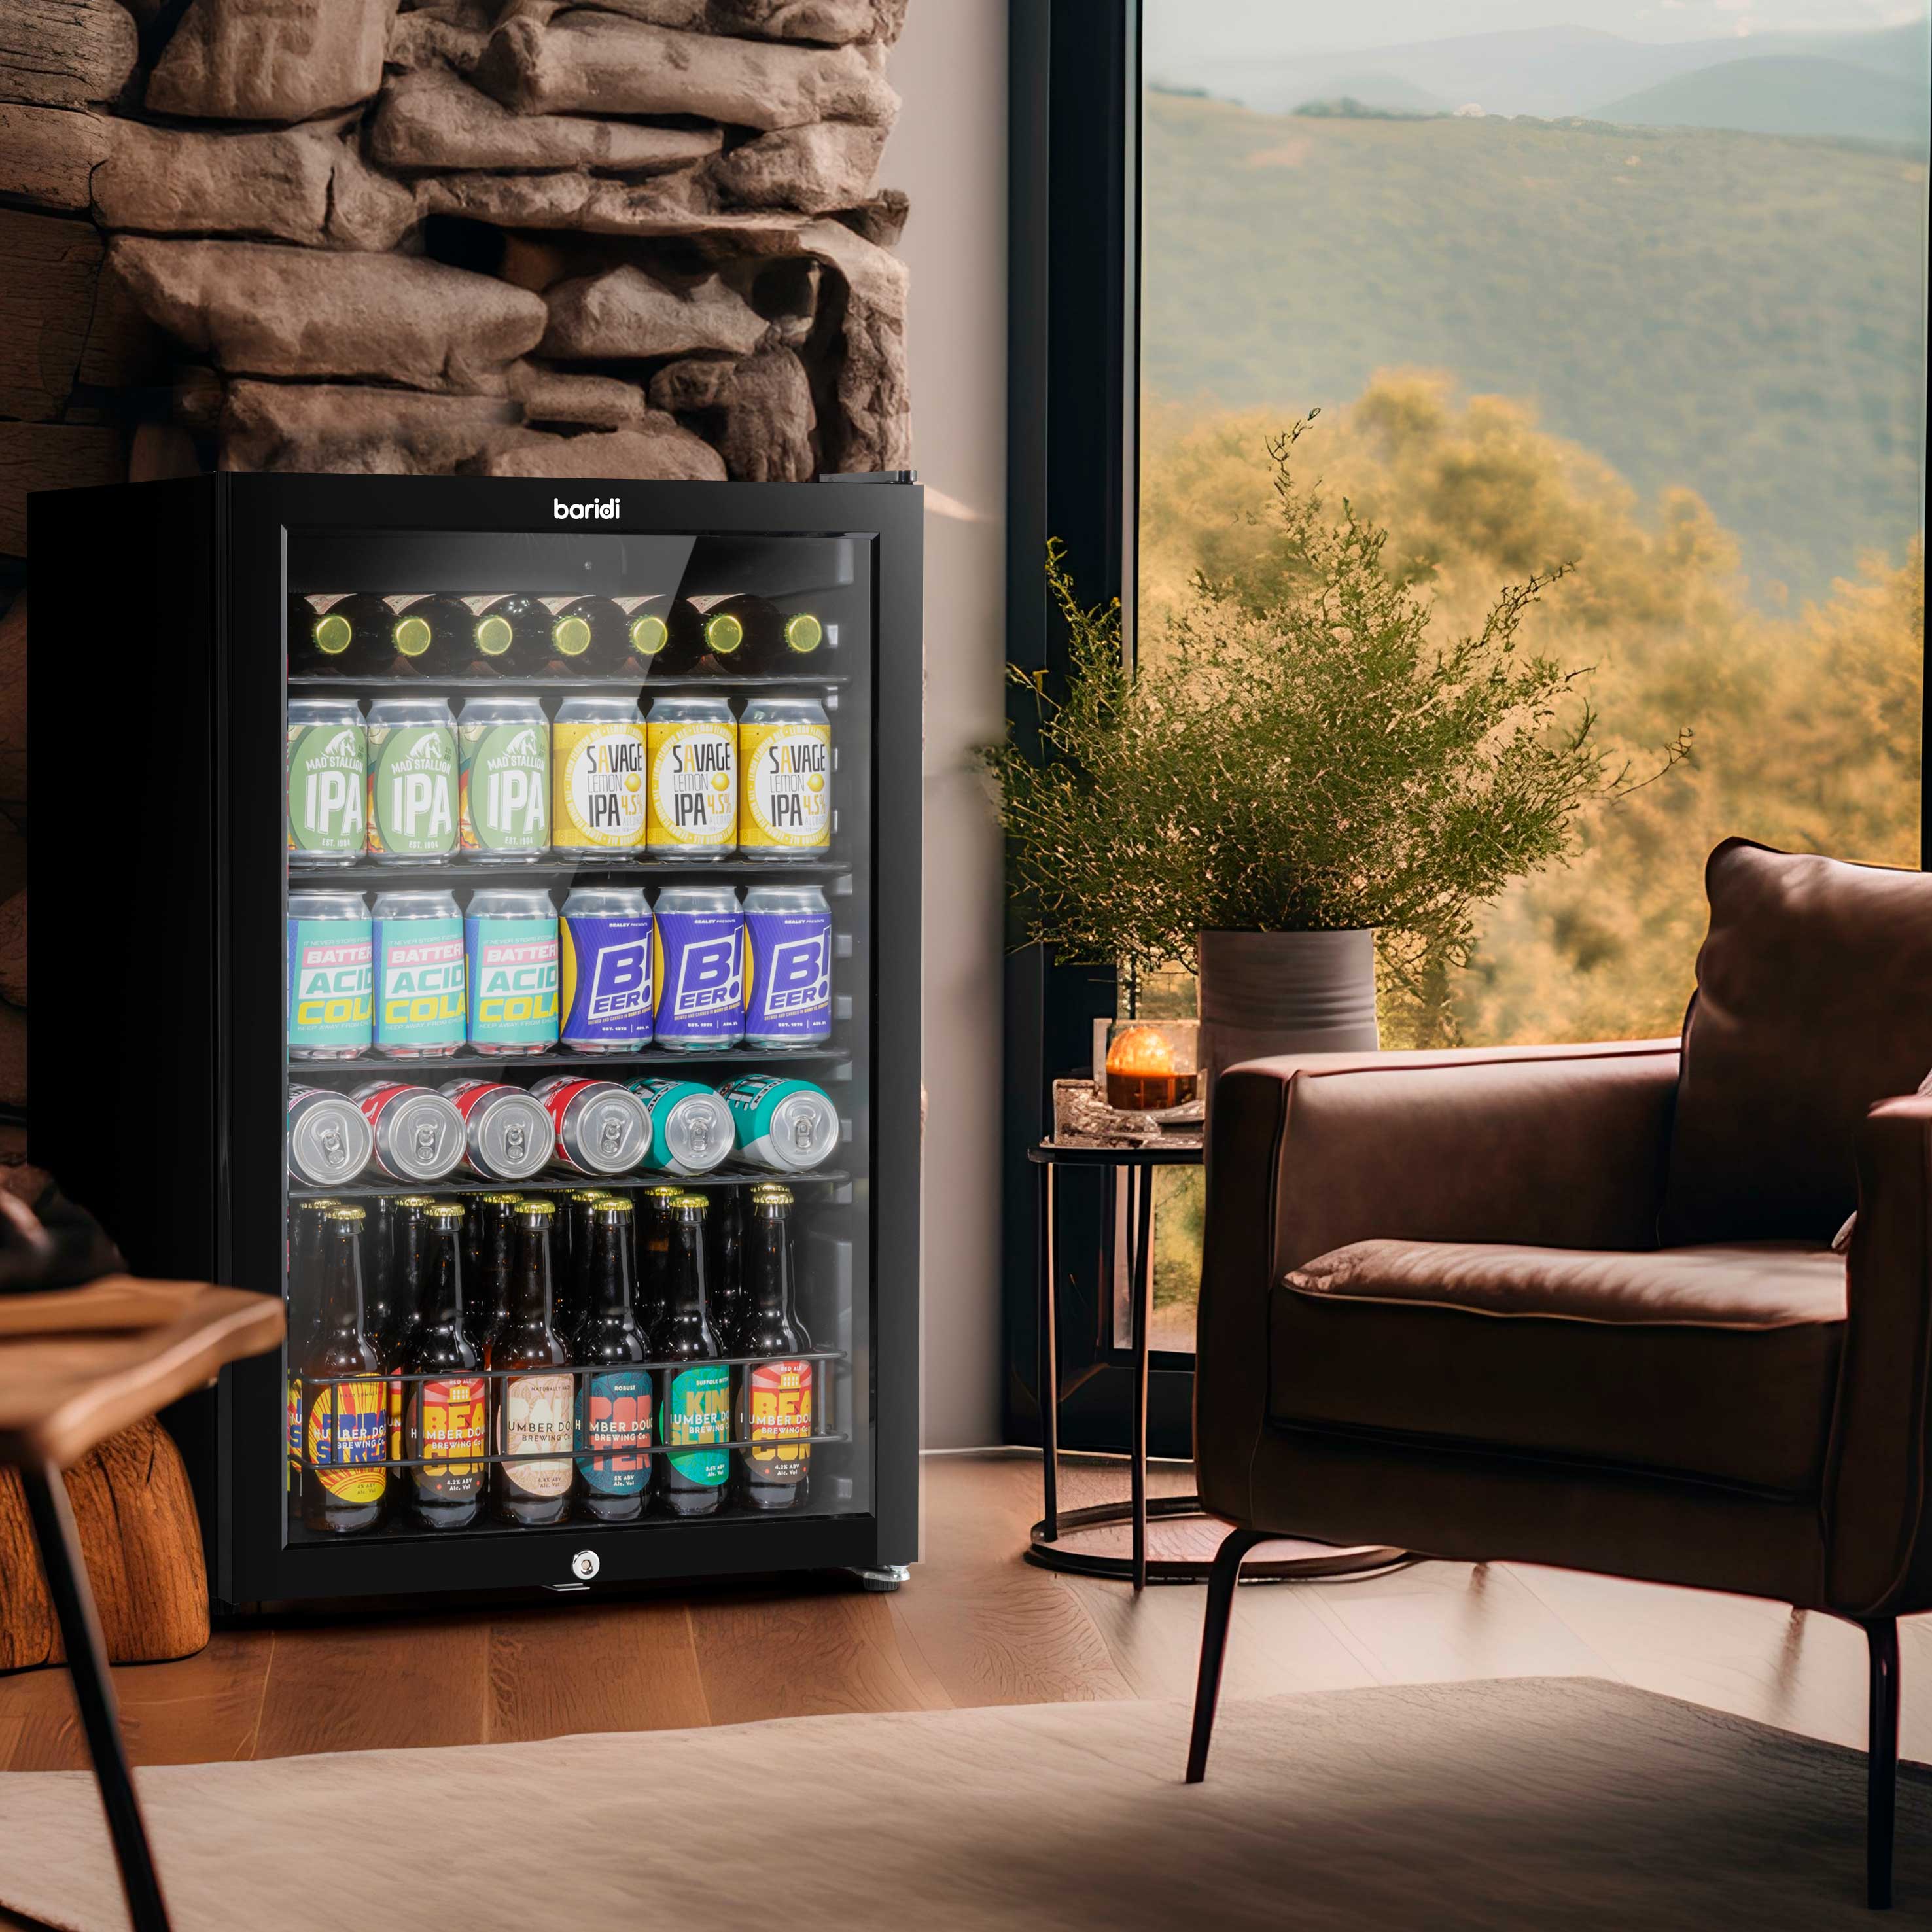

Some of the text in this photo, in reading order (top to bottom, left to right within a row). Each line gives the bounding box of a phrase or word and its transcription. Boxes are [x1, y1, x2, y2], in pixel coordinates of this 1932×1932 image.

[554, 498, 620, 519] baridi
[306, 756, 364, 773] MAD STALLION
[391, 758, 451, 775] MAD STALLION
[487, 755, 545, 771] MAD STALLION
[586, 743, 642, 774] SAVAGE
[673, 743, 731, 773] SAVAGE
[769, 744, 825, 774] SAVAGE
[588, 774, 622, 793] LEMON
[673, 773, 709, 792] LEMON
[770, 775, 805, 793] LEMON
[304, 771, 362, 836] IPA
[391, 773, 452, 838] IPA
[487, 770, 545, 834] IPA
[588, 794, 621, 827] IPA
[621, 794, 642, 815] 4.5%
[675, 793, 707, 826] IPA
[707, 793, 731, 814] 4.5%
[771, 794, 803, 827] IPA
[803, 794, 826, 815] 4.5%
[321, 838, 335, 847] EST.
[307, 946, 372, 964] BATTER
[487, 944, 555, 962] BATTER
[391, 964, 464, 994] ACID
[687, 1386, 729, 1417] KIN
[508, 1421, 572, 1432] UMBER DO
[576, 1419, 626, 1432] HMBER
[671, 1413, 717, 1424] UMBER
[741, 1413, 791, 1426] UMBER
[313, 1427, 368, 1439] HUBER
[411, 1428, 462, 1440] HMBER
[689, 1424, 724, 1433] BREWING
[338, 1439, 376, 1449] BREWING
[432, 1441, 471, 1449] BREWING
